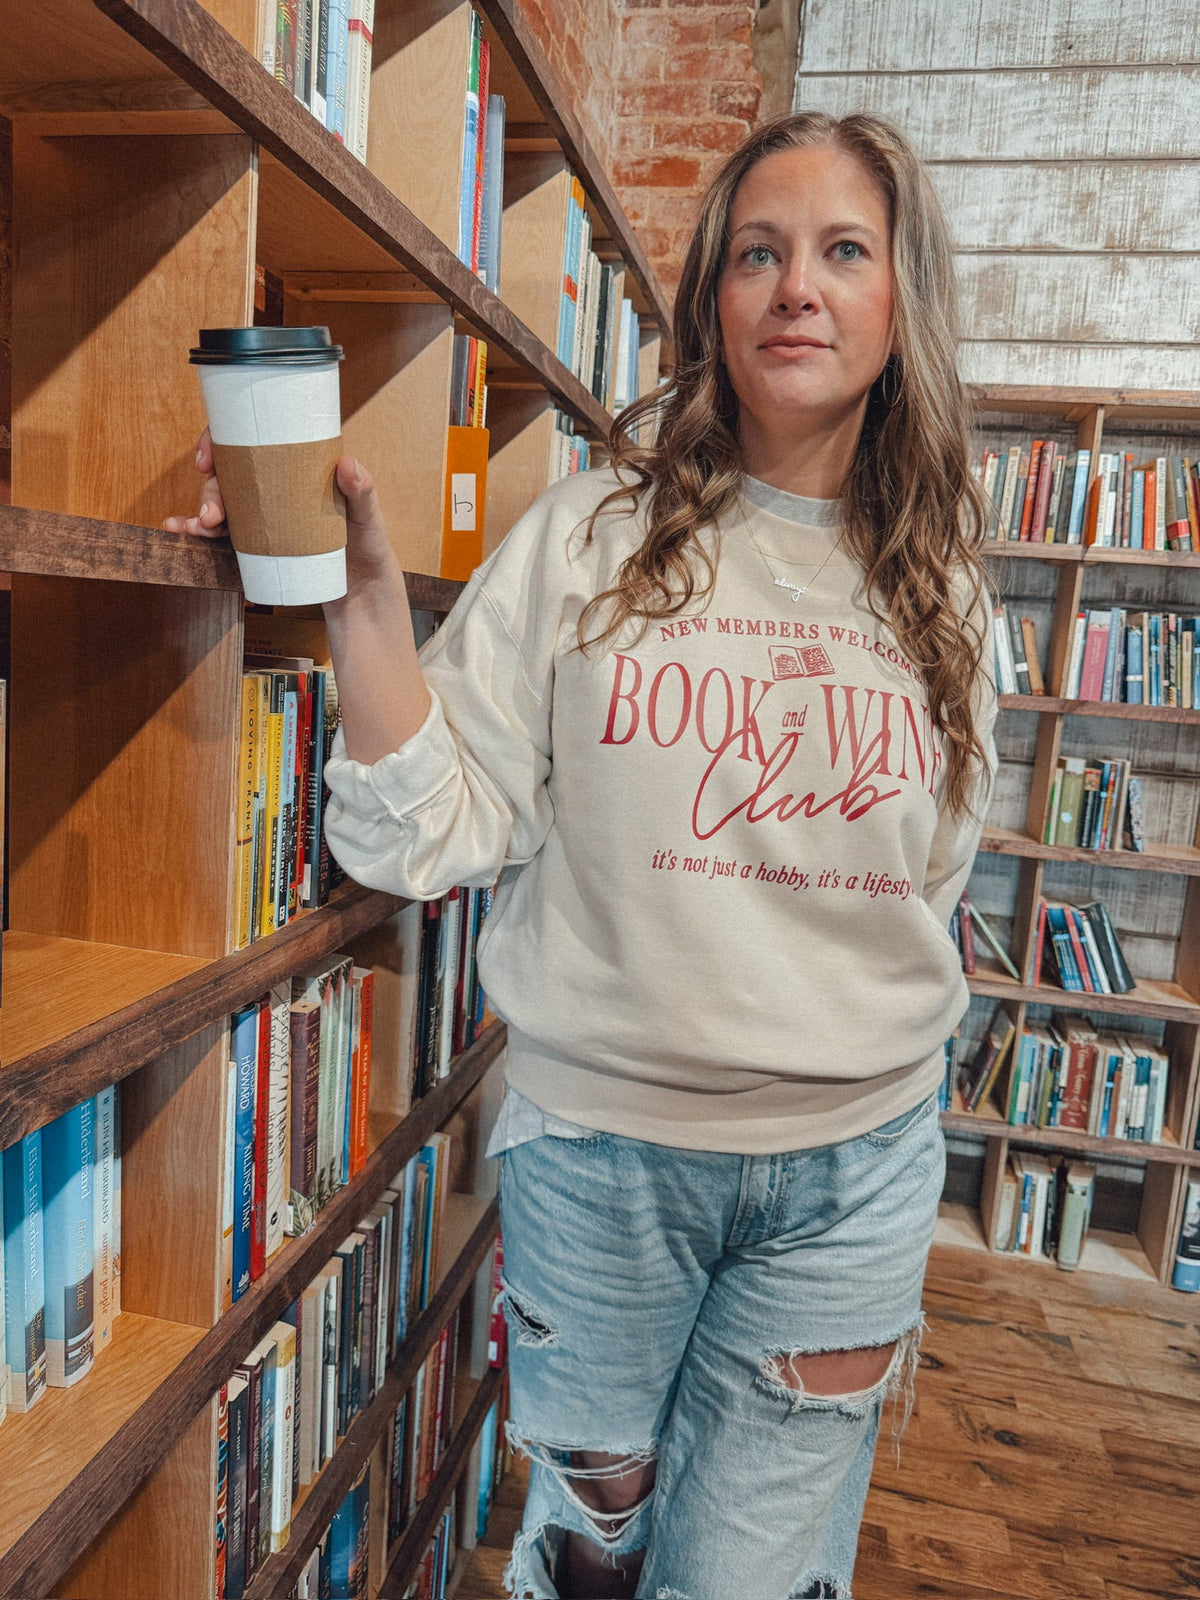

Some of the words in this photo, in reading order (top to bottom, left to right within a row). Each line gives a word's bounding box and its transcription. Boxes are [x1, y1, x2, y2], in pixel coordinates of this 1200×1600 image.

[319, 38, 327, 75] EARTH
[659, 617, 709, 642] NEW
[716, 616, 820, 640] MEMBERS
[599, 652, 776, 767] BOOK
[781, 703, 809, 728] and
[246, 708, 255, 771] LOVING
[692, 729, 902, 841] Club
[652, 849, 678, 871] it's
[682, 854, 709, 874] not
[709, 857, 737, 880] just
[740, 864, 753, 879] a
[755, 861, 810, 891] hobby,
[817, 869, 841, 889] it's
[845, 875, 859, 890] a
[862, 871, 915, 901] lifesty
[239, 1055, 251, 1110] HOWARD
[79, 1102, 92, 1201] Hilderbrand
[101, 1111, 110, 1140] ELIN
[28, 1146, 38, 1182] Elin
[102, 1142, 111, 1224] HILDERBRAND
[242, 1141, 252, 1196] KILLING
[29, 1184, 40, 1280] Hilderbrand
[77, 1217, 88, 1249] Hotel
[241, 1198, 251, 1233] TIME
[76, 1251, 88, 1311] Nantucket
[99, 1278, 110, 1315] people
